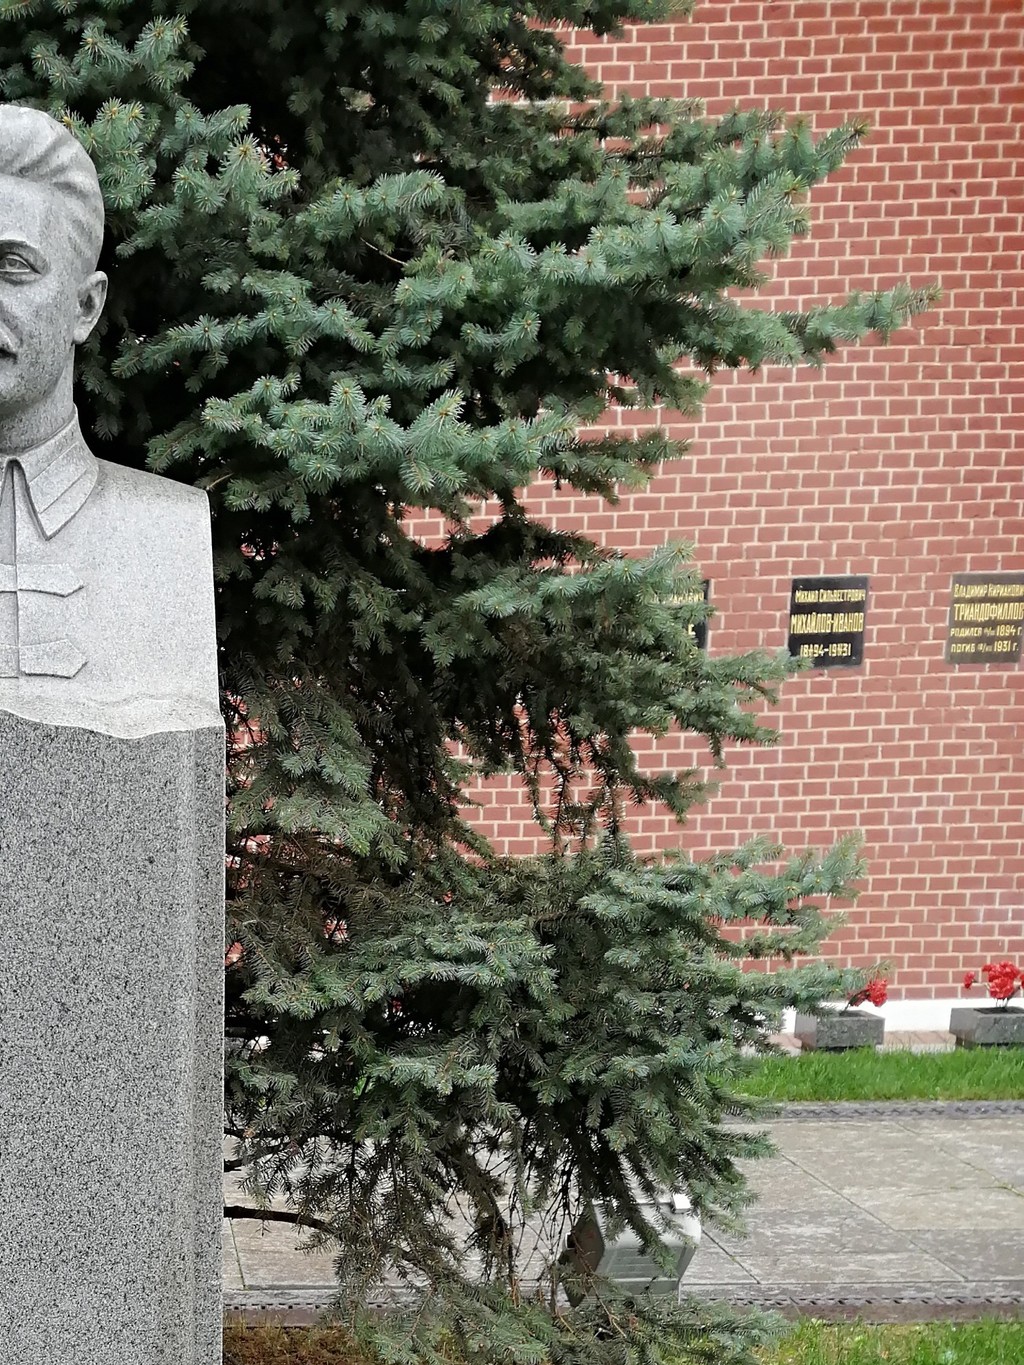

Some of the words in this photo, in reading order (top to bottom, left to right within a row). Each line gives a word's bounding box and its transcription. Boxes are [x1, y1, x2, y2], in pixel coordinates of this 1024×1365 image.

[790, 612, 865, 634] МИХАЙЛОВ-ИВАНОВ
[996, 624, 1016, 636] 1894
[951, 643, 976, 653] ПОГИБ
[994, 640, 1011, 652] 1931
